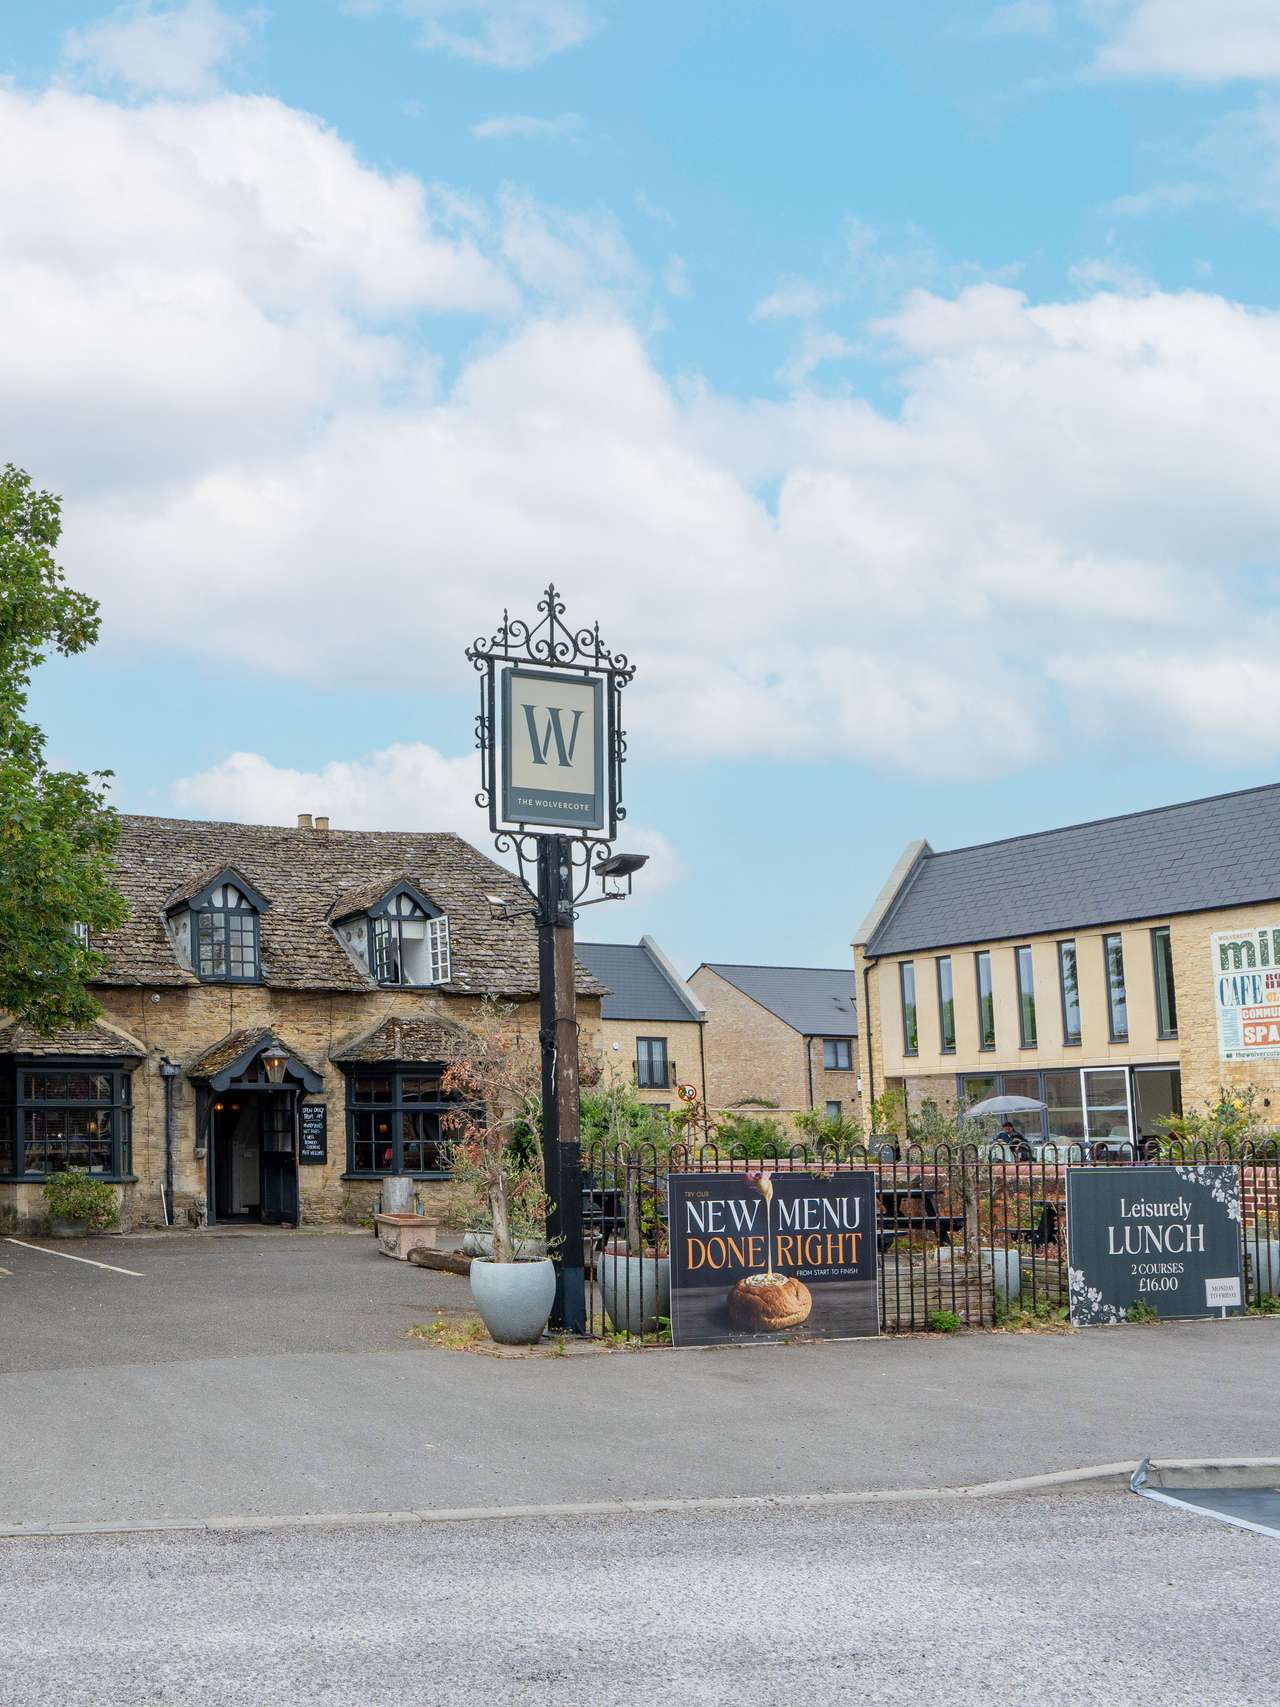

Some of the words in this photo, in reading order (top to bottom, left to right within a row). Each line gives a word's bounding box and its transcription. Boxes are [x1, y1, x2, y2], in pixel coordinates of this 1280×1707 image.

[520, 703, 585, 768] W
[517, 798, 533, 807] THE
[534, 799, 590, 812] WOLVERCOTE
[686, 1200, 761, 1233] NEW
[777, 1197, 862, 1231] MENU
[1120, 1196, 1192, 1221] Leisurely
[687, 1235, 766, 1270] DONE
[776, 1232, 862, 1266] RIGHT
[1109, 1223, 1206, 1255] LUNCH
[814, 1268, 830, 1276] START
[1131, 1263, 1138, 1275] 2
[1138, 1262, 1184, 1275] COURSES
[1139, 1276, 1178, 1292] £16.00
